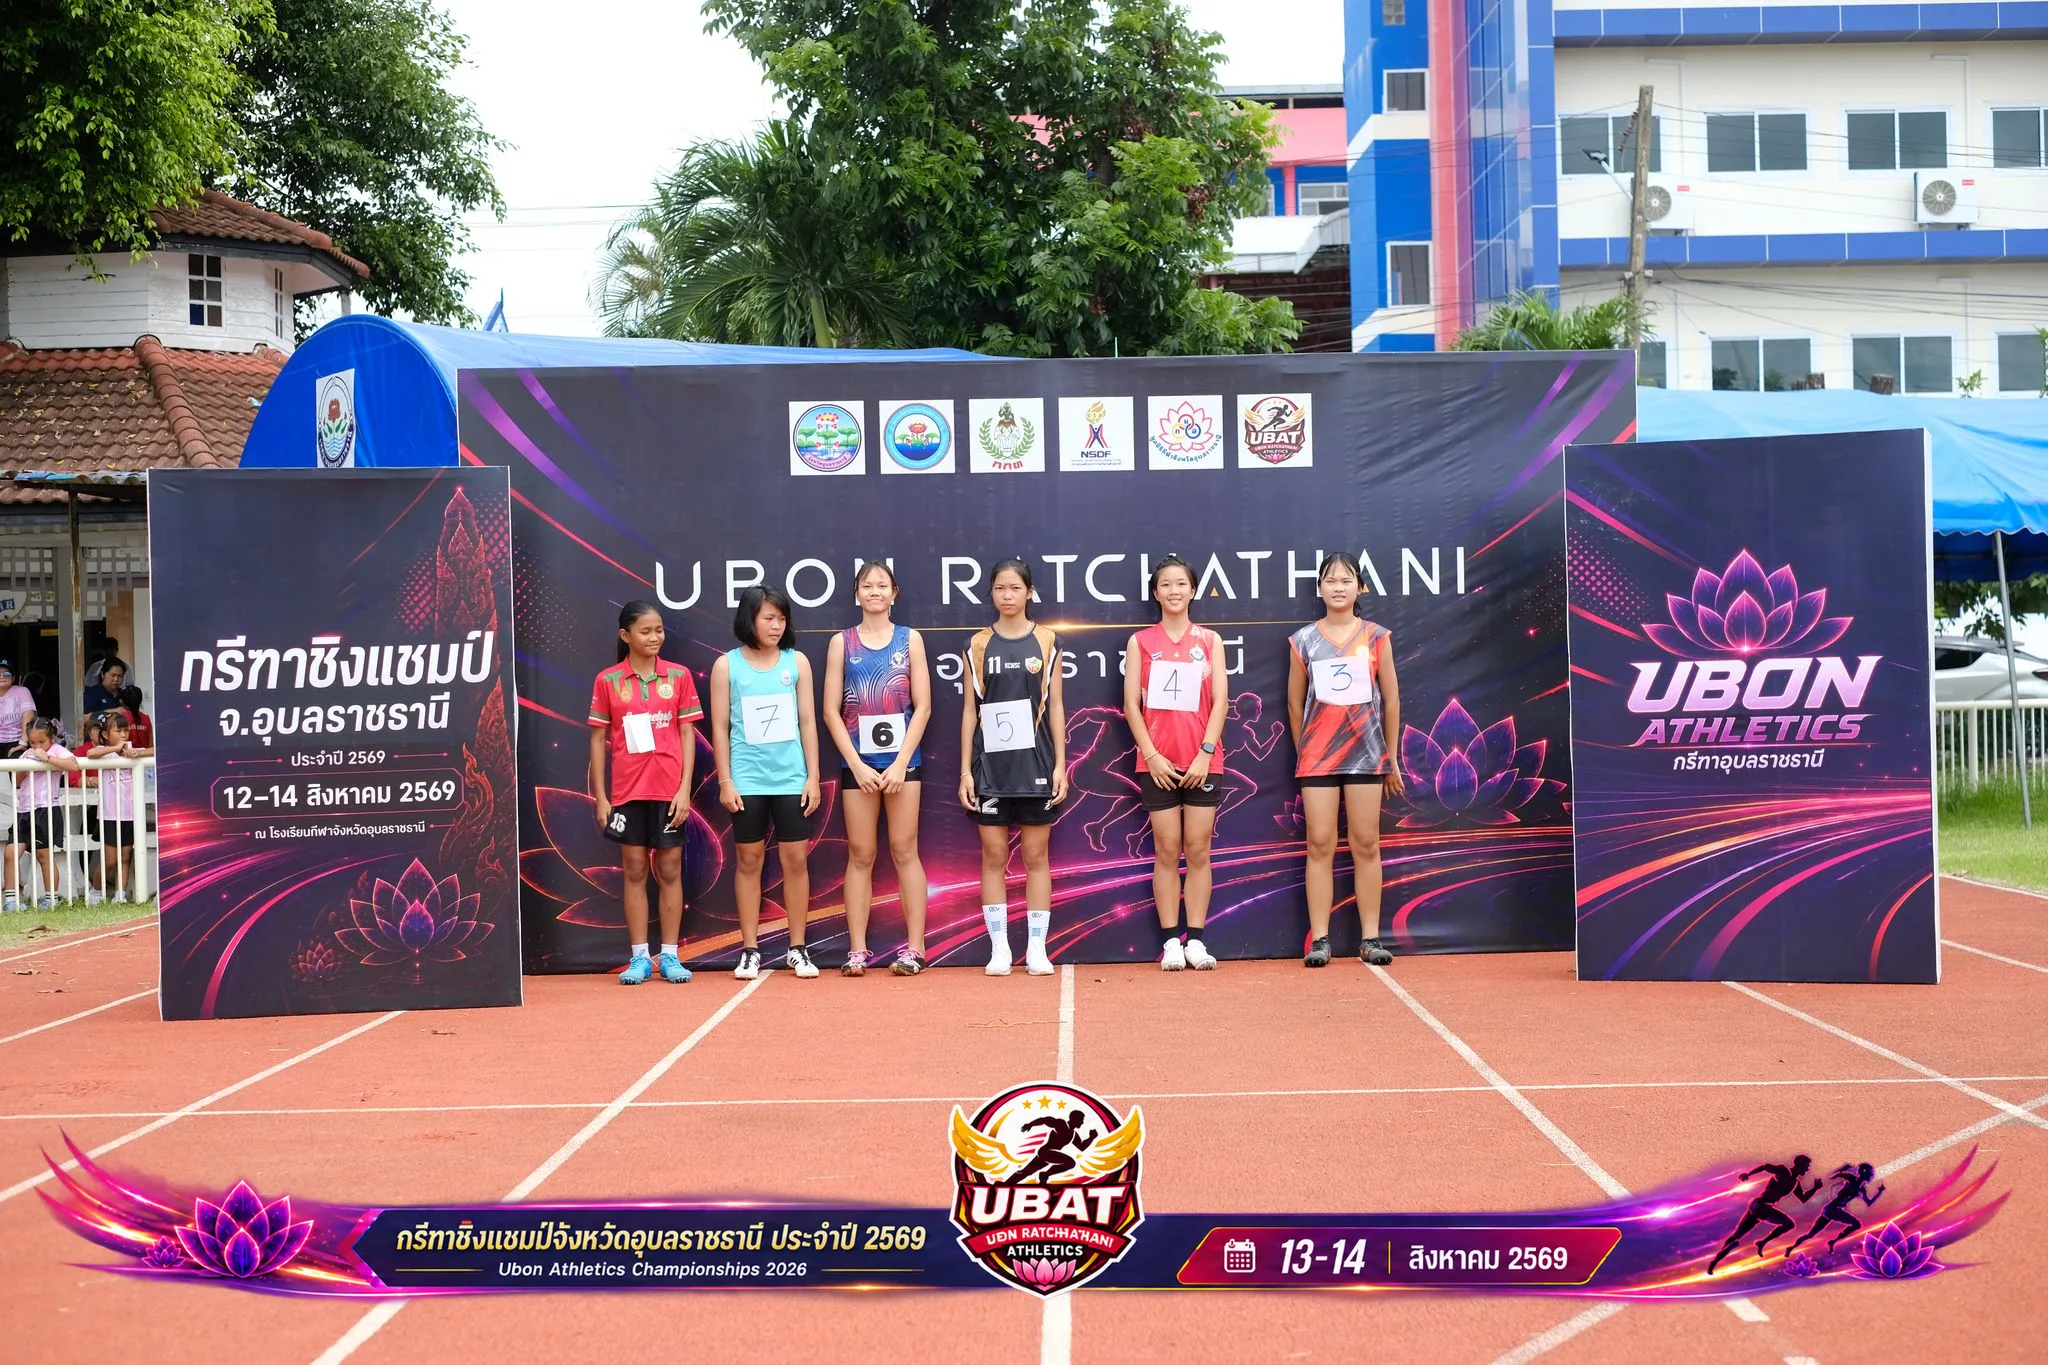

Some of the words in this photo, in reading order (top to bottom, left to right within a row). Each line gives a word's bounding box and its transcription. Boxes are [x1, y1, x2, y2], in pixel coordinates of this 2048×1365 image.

[1250, 431, 1301, 445] UBAT
[180, 630, 495, 692] กรีฑาชิงแชมป์
[988, 656, 1001, 674] 11
[1163, 669, 1182, 700] 4
[1330, 664, 1353, 691] 3
[1627, 656, 1884, 713] UBON
[756, 704, 780, 737] 7
[995, 712, 1014, 742] 5
[1642, 714, 1874, 744] ATHLETICS
[872, 722, 894, 747] 6
[291, 751, 343, 767] ประจำปี
[348, 750, 386, 766] 2569
[307, 783, 391, 807] สิงหาคม
[399, 780, 456, 803] 2569
[255, 830, 266, 839] ณ
